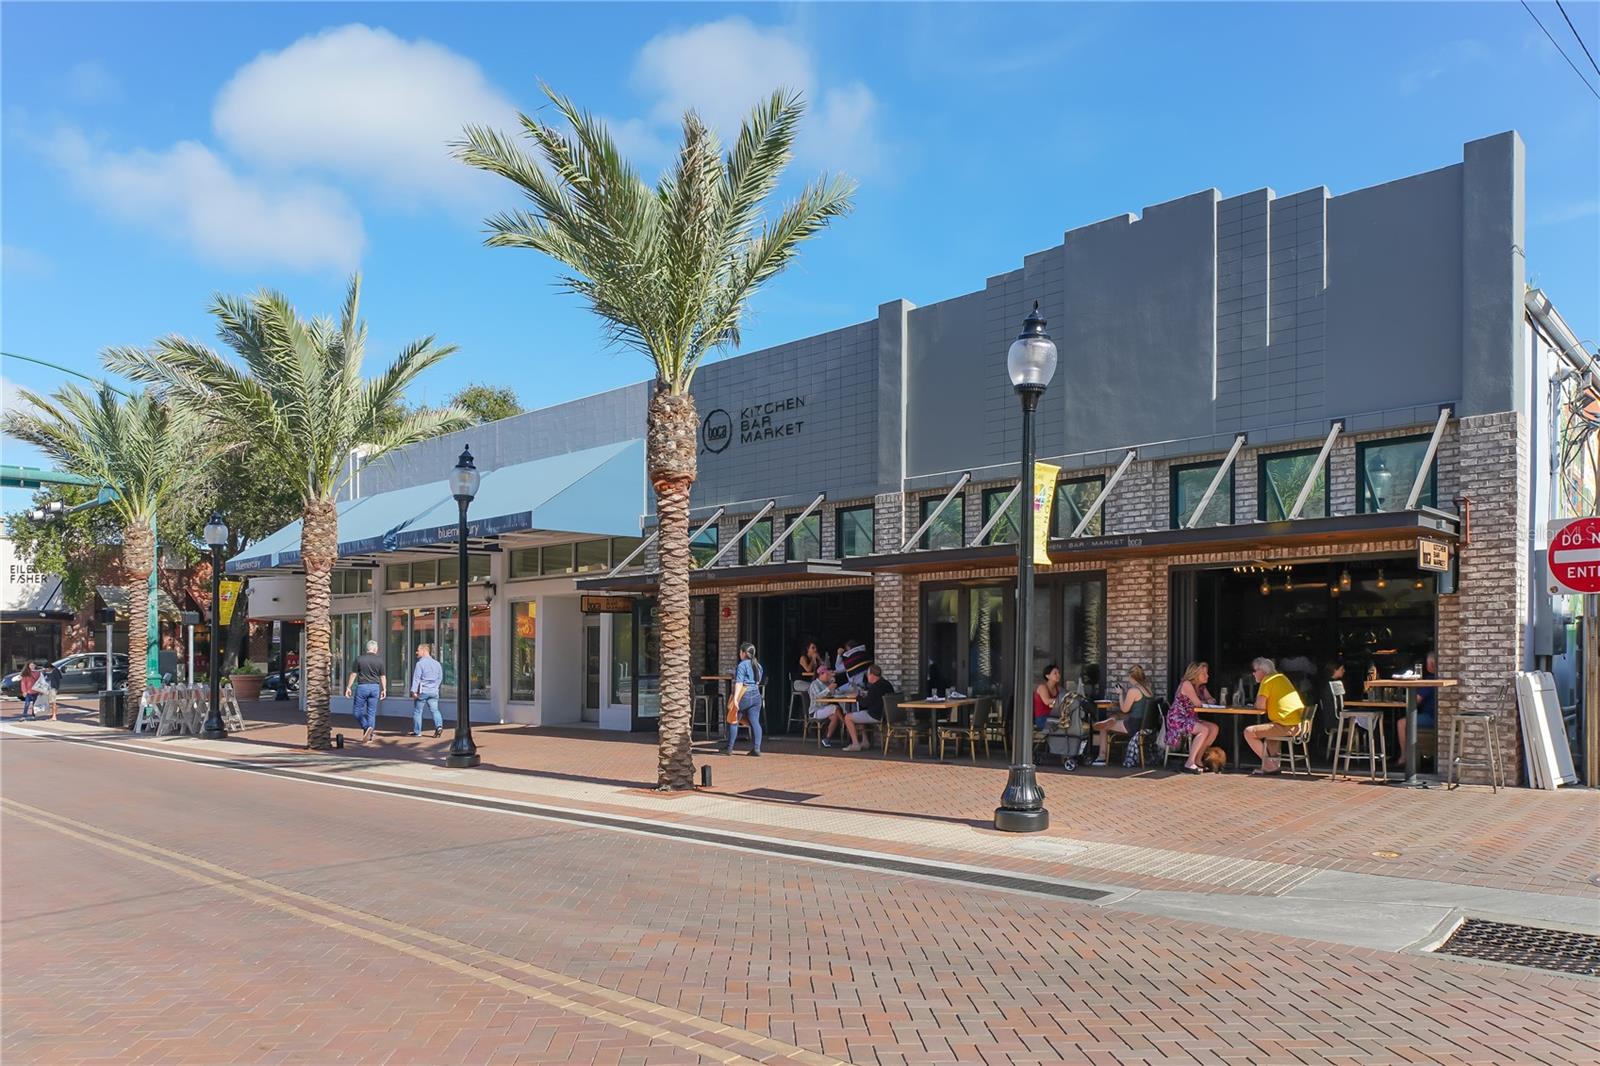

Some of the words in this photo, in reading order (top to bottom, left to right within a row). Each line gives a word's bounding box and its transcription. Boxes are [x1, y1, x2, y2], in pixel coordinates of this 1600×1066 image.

[740, 396, 805, 419] KITCHEN
[707, 420, 727, 440] boca
[740, 415, 772, 431] BAR
[740, 421, 805, 444] MARKET
[437, 523, 480, 540] bluemury
[1561, 533, 1582, 546] DO
[1091, 538, 1124, 546] MARKET
[10, 564, 44, 574] EILE
[10, 574, 48, 584] FISHER
